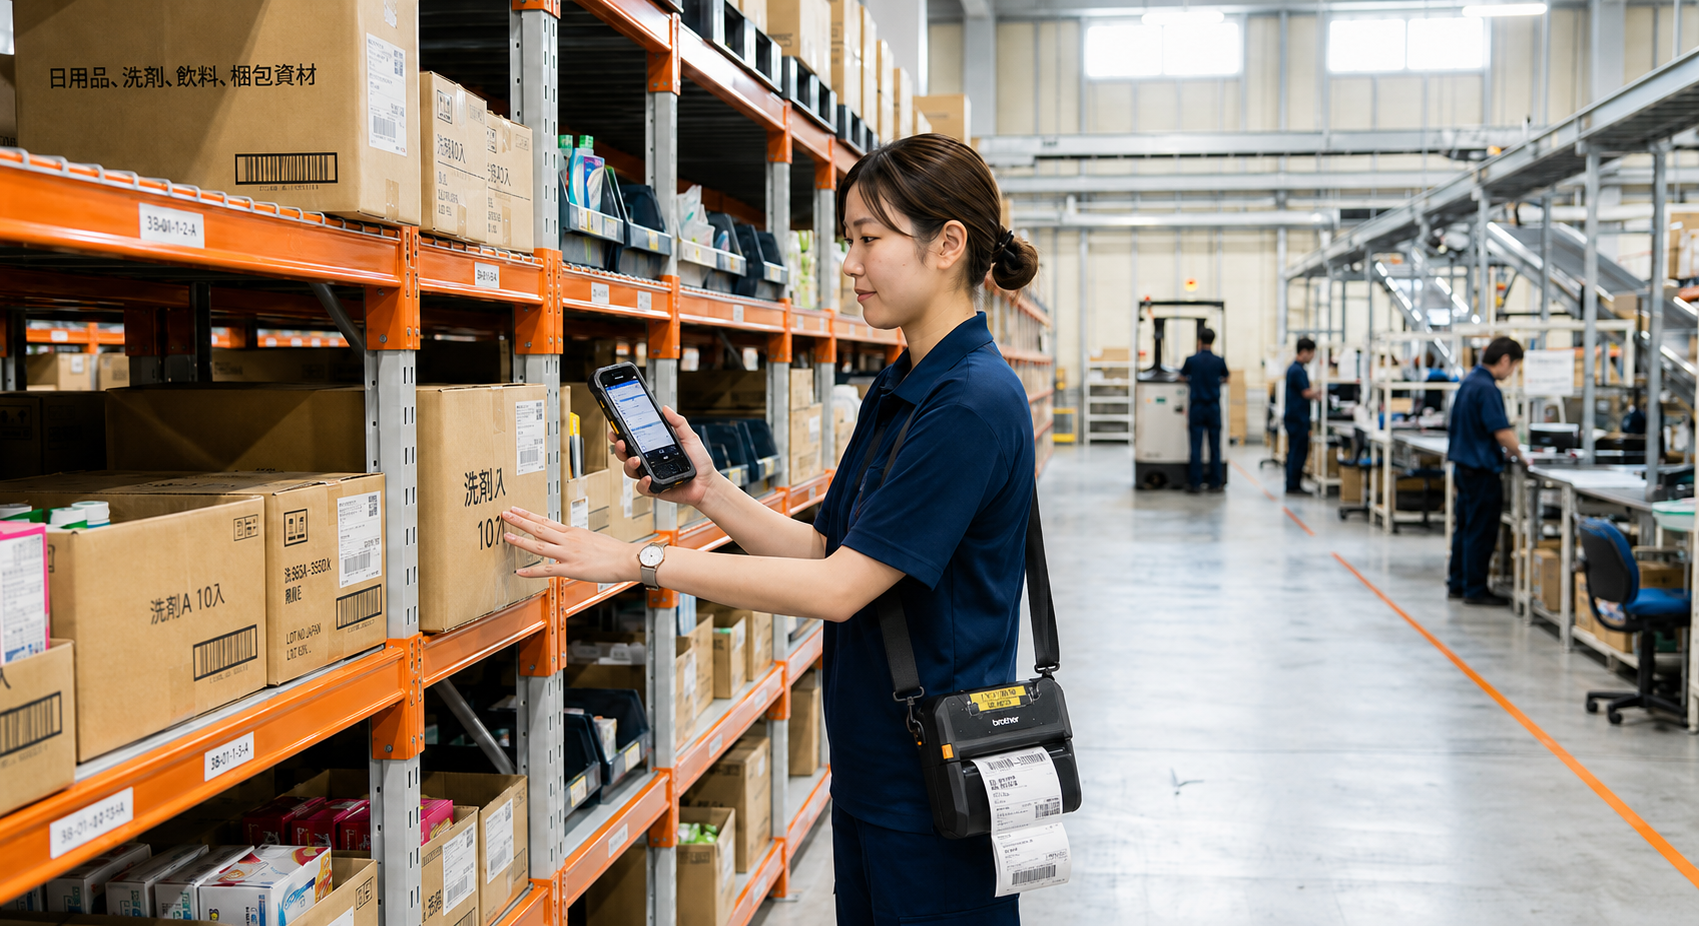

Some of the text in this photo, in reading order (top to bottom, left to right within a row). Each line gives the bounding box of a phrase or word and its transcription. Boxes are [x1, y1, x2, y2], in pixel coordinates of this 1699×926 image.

[50, 63, 318, 89] 日用品、洗剤、飲料、梱包資材
[464, 467, 506, 507] 洗剤入
[150, 583, 225, 625] 洗剤A 10入
[992, 716, 1019, 727] brother
